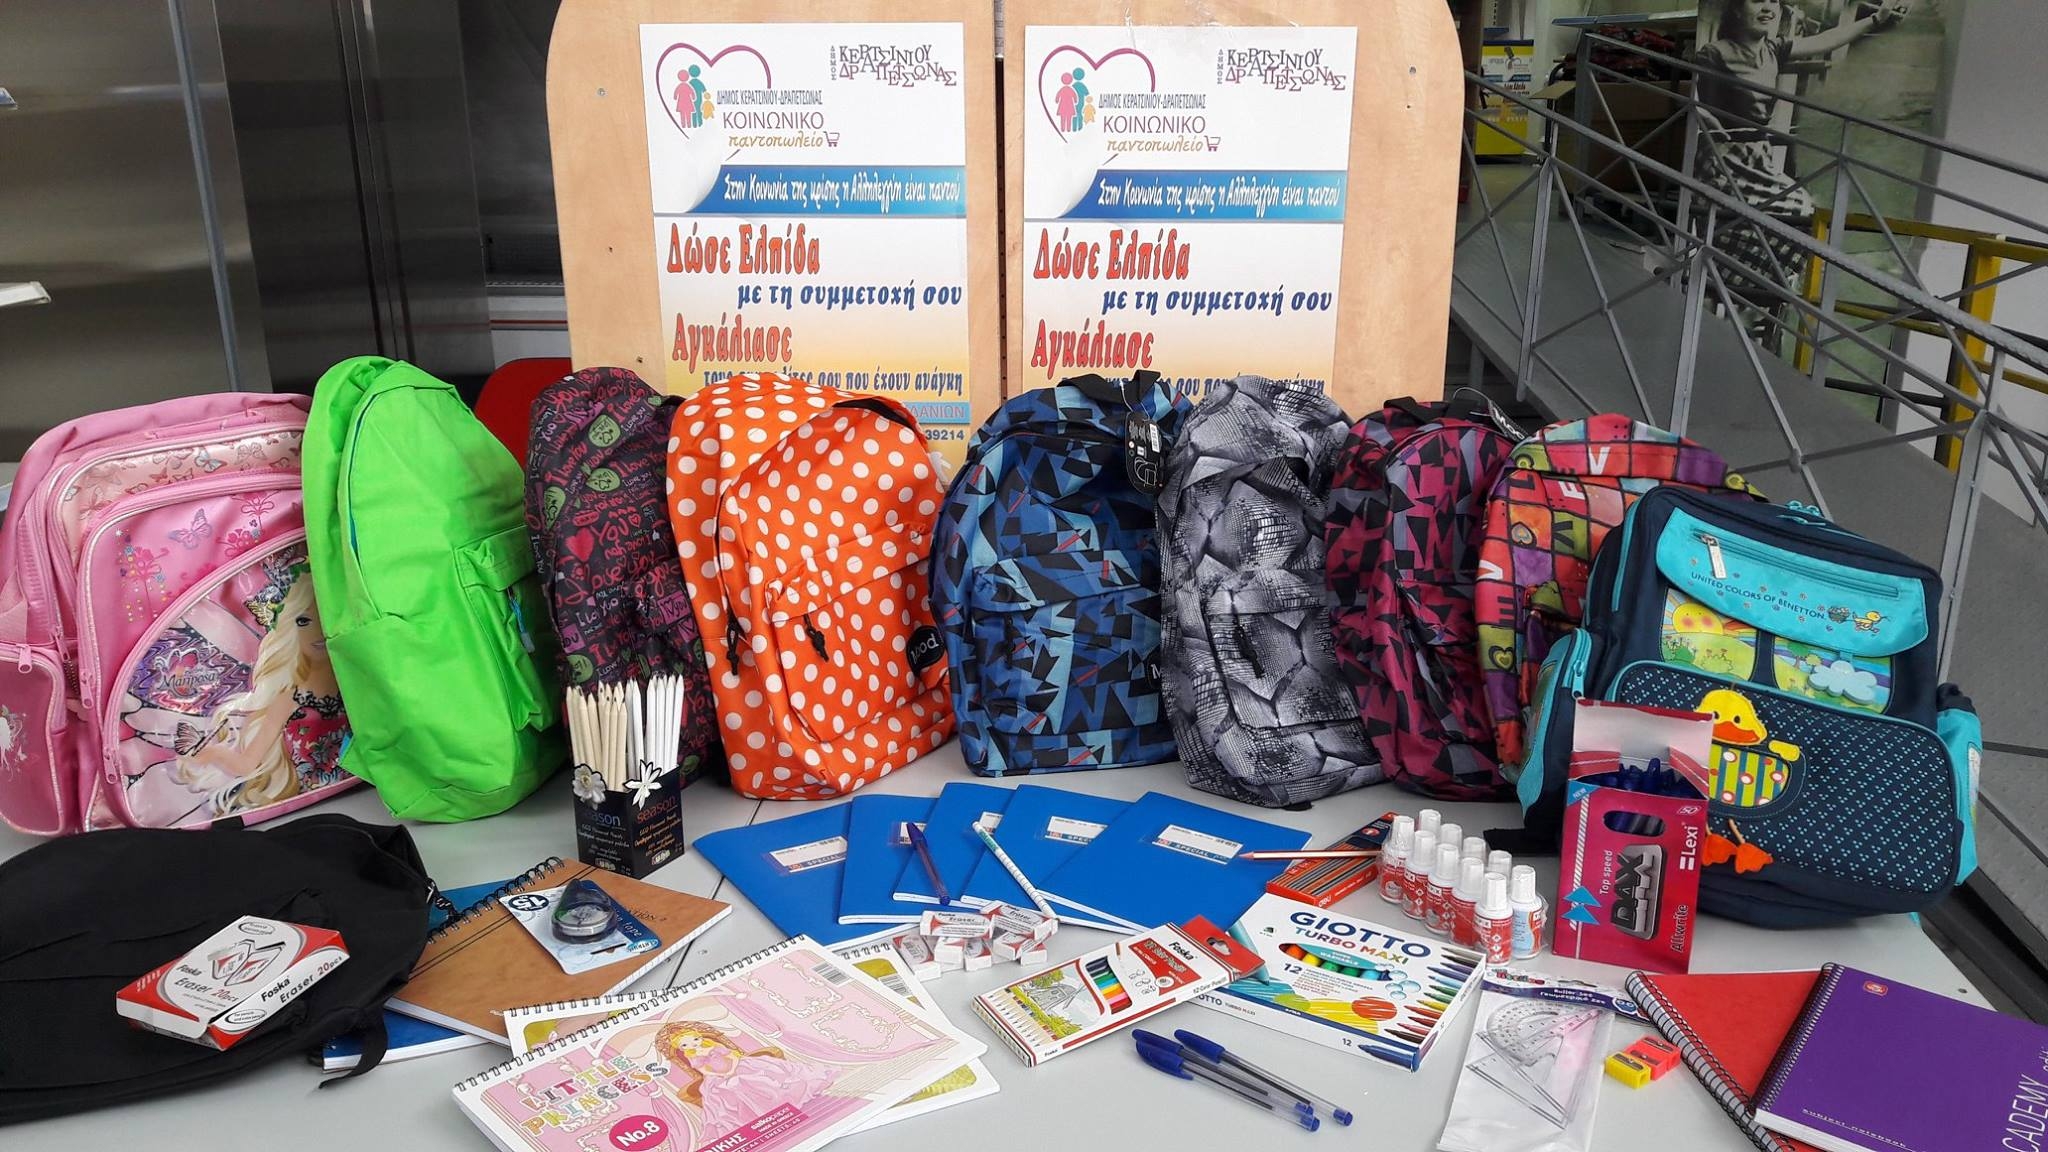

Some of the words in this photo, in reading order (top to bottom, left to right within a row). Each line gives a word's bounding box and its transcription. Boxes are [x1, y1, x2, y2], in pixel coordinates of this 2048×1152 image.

[717, 90, 739, 105] ΔΗΜΟΣ
[1099, 94, 1122, 109] ΔΗΜΟΣ
[723, 111, 824, 129] ΚΟΙΝΩΝΙΚΟ
[1103, 115, 1206, 134] ΚΟΙΝΩΝΙΚΟ
[728, 130, 824, 147] παντοπωλείο
[1107, 135, 1204, 152] παντοπωλείο
[749, 172, 789, 203] Κοινωνία
[791, 182, 808, 208] της
[904, 174, 926, 202] είναι
[928, 174, 960, 201] παντού
[1122, 176, 1163, 207] Κοινωνία
[1165, 185, 1182, 212] της
[1282, 179, 1305, 206] είναι
[1307, 178, 1340, 207] παντού
[667, 222, 731, 274] Δώσε
[738, 223, 820, 275] Ελπίδα
[1033, 227, 1100, 279] Δώσε
[1106, 227, 1190, 280] Ελπίδα
[737, 285, 762, 309] με
[770, 285, 793, 309] τη
[800, 280, 915, 311] συμμετοχή
[923, 286, 962, 304] σου
[1102, 290, 1127, 315] με
[1135, 290, 1158, 315] τη
[1165, 284, 1284, 317] συμμετοχή
[1291, 290, 1332, 311] σου
[671, 312, 793, 373] Αγκάλιασε
[1031, 318, 1154, 380] Αγκάλιασε
[818, 373, 841, 390] σου
[846, 372, 869, 391] που
[873, 366, 911, 391] έχουν
[915, 368, 962, 396] ανάγκη
[926, 429, 964, 440] 39214
[1691, 571, 1723, 589] UNITED
[1724, 584, 1761, 600] COLORS
[1763, 594, 1776, 603] OF
[157, 671, 216, 690] Mariposa
[637, 795, 676, 824] season
[1681, 825, 1699, 858] Lexi
[1602, 850, 1613, 877] speed
[1599, 876, 1610, 895] Top
[622, 921, 642, 938] tape
[1290, 911, 1431, 958] GIOTTO
[1671, 904, 1689, 953] Allwrite
[1168, 941, 1194, 960] Foska
[1295, 926, 1357, 951] TURBO
[1360, 945, 1410, 965] MAXI
[176, 964, 202, 976] Foska
[279, 974, 314, 1004] Eraser
[317, 956, 342, 976] 20pcs
[1284, 963, 1302, 974] 12
[174, 977, 213, 993] Eraser
[211, 988, 239, 1003] 20pcs
[261, 978, 290, 1002] Foska
[1195, 993, 1222, 1006] OTTO
[1342, 1037, 1352, 1047] 12
[521, 1055, 636, 1112] LITTLE
[2001, 1073, 2048, 1152] CADEMY
[616, 1120, 660, 1147] No.8
